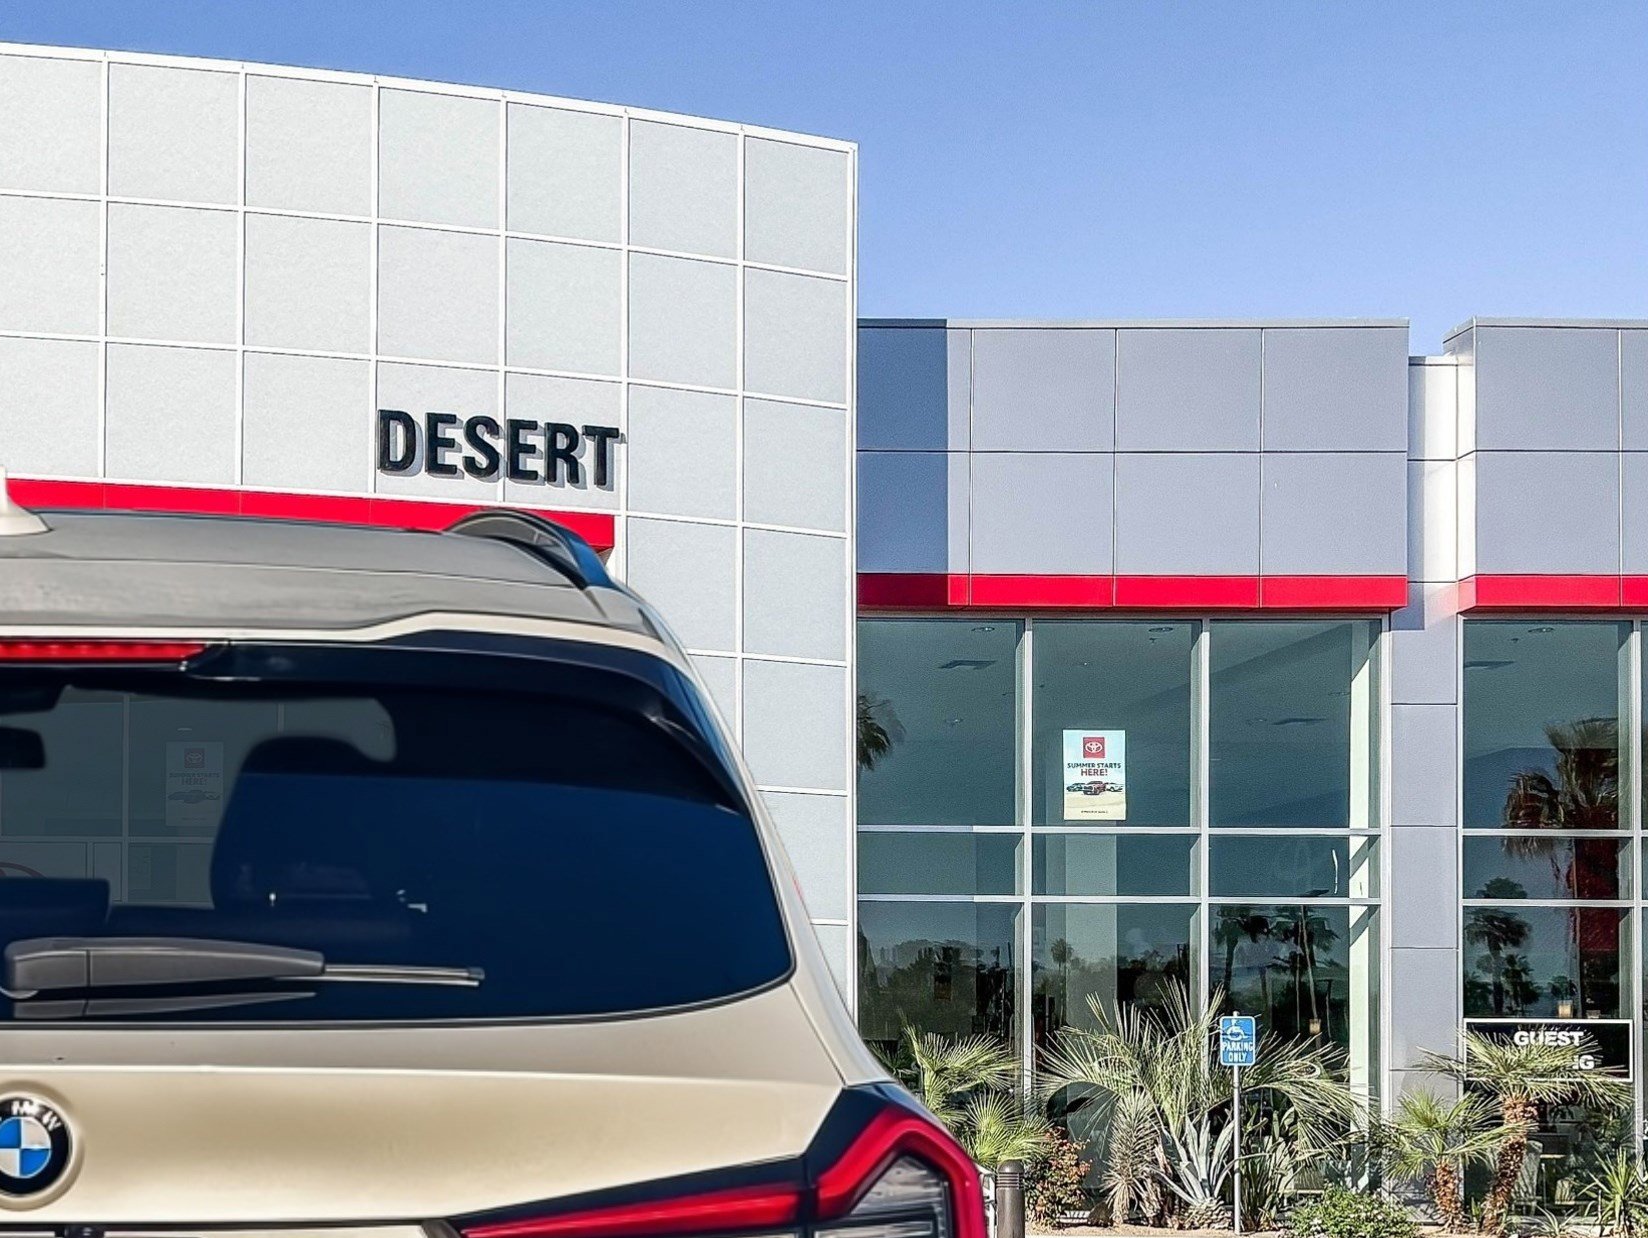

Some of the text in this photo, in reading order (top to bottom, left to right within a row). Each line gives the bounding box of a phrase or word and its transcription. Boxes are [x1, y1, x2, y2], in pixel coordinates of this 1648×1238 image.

[377, 409, 620, 487] DESERT
[1080, 768, 1108, 776] HERE!
[1513, 1030, 1584, 1047] GUEST
[1222, 1041, 1254, 1052] PARKING
[1228, 1051, 1248, 1063] ONLY
